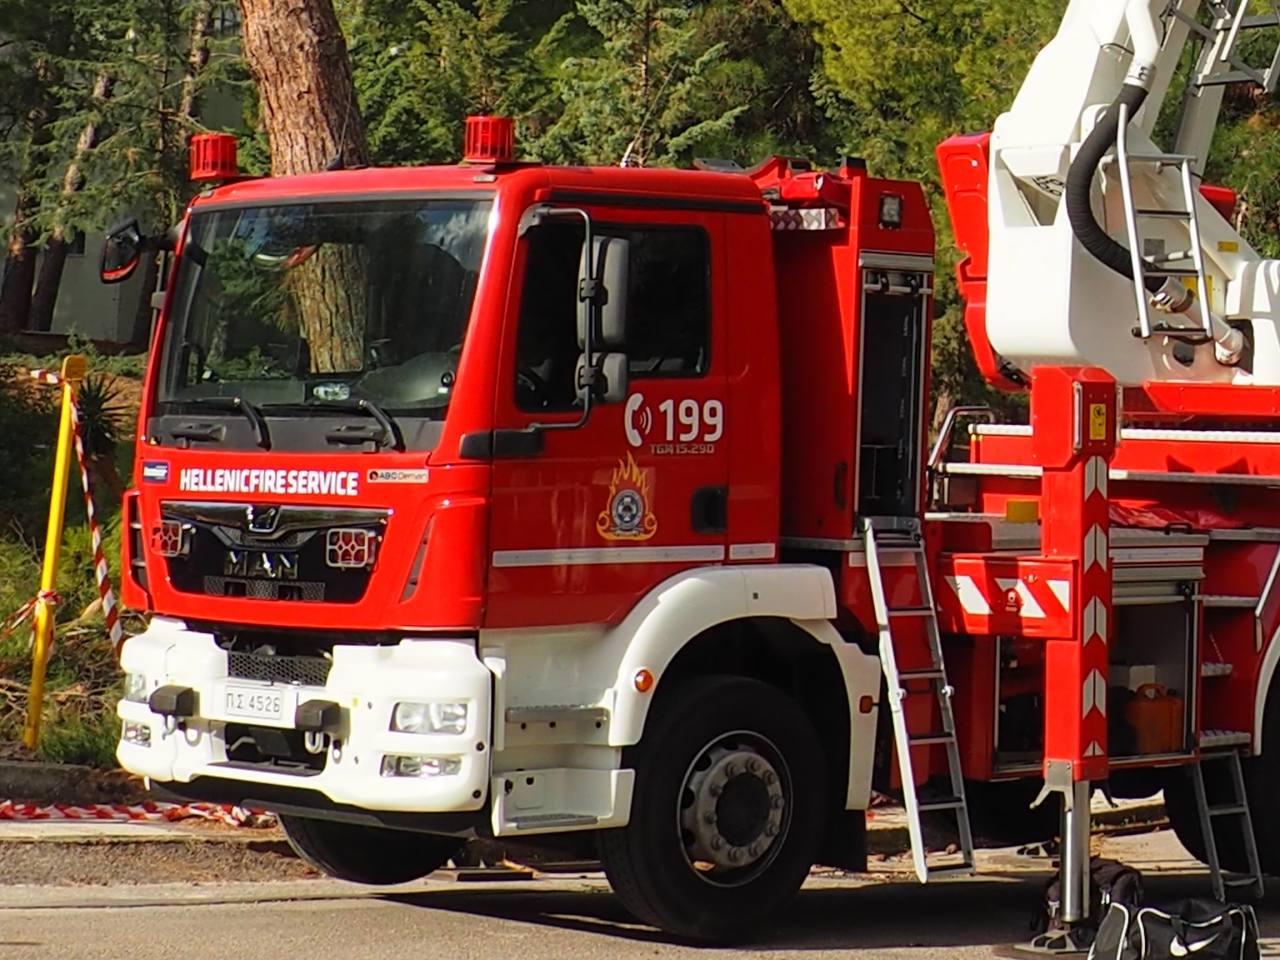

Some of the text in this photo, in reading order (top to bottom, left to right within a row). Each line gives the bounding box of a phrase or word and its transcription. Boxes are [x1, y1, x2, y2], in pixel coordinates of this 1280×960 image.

[659, 399, 723, 442] 199
[180, 467, 251, 493] HELLENIC
[250, 469, 287, 494] FIRE
[287, 470, 359, 496] SERVICE
[224, 549, 300, 580] MAN
[248, 695, 280, 713] 4526
